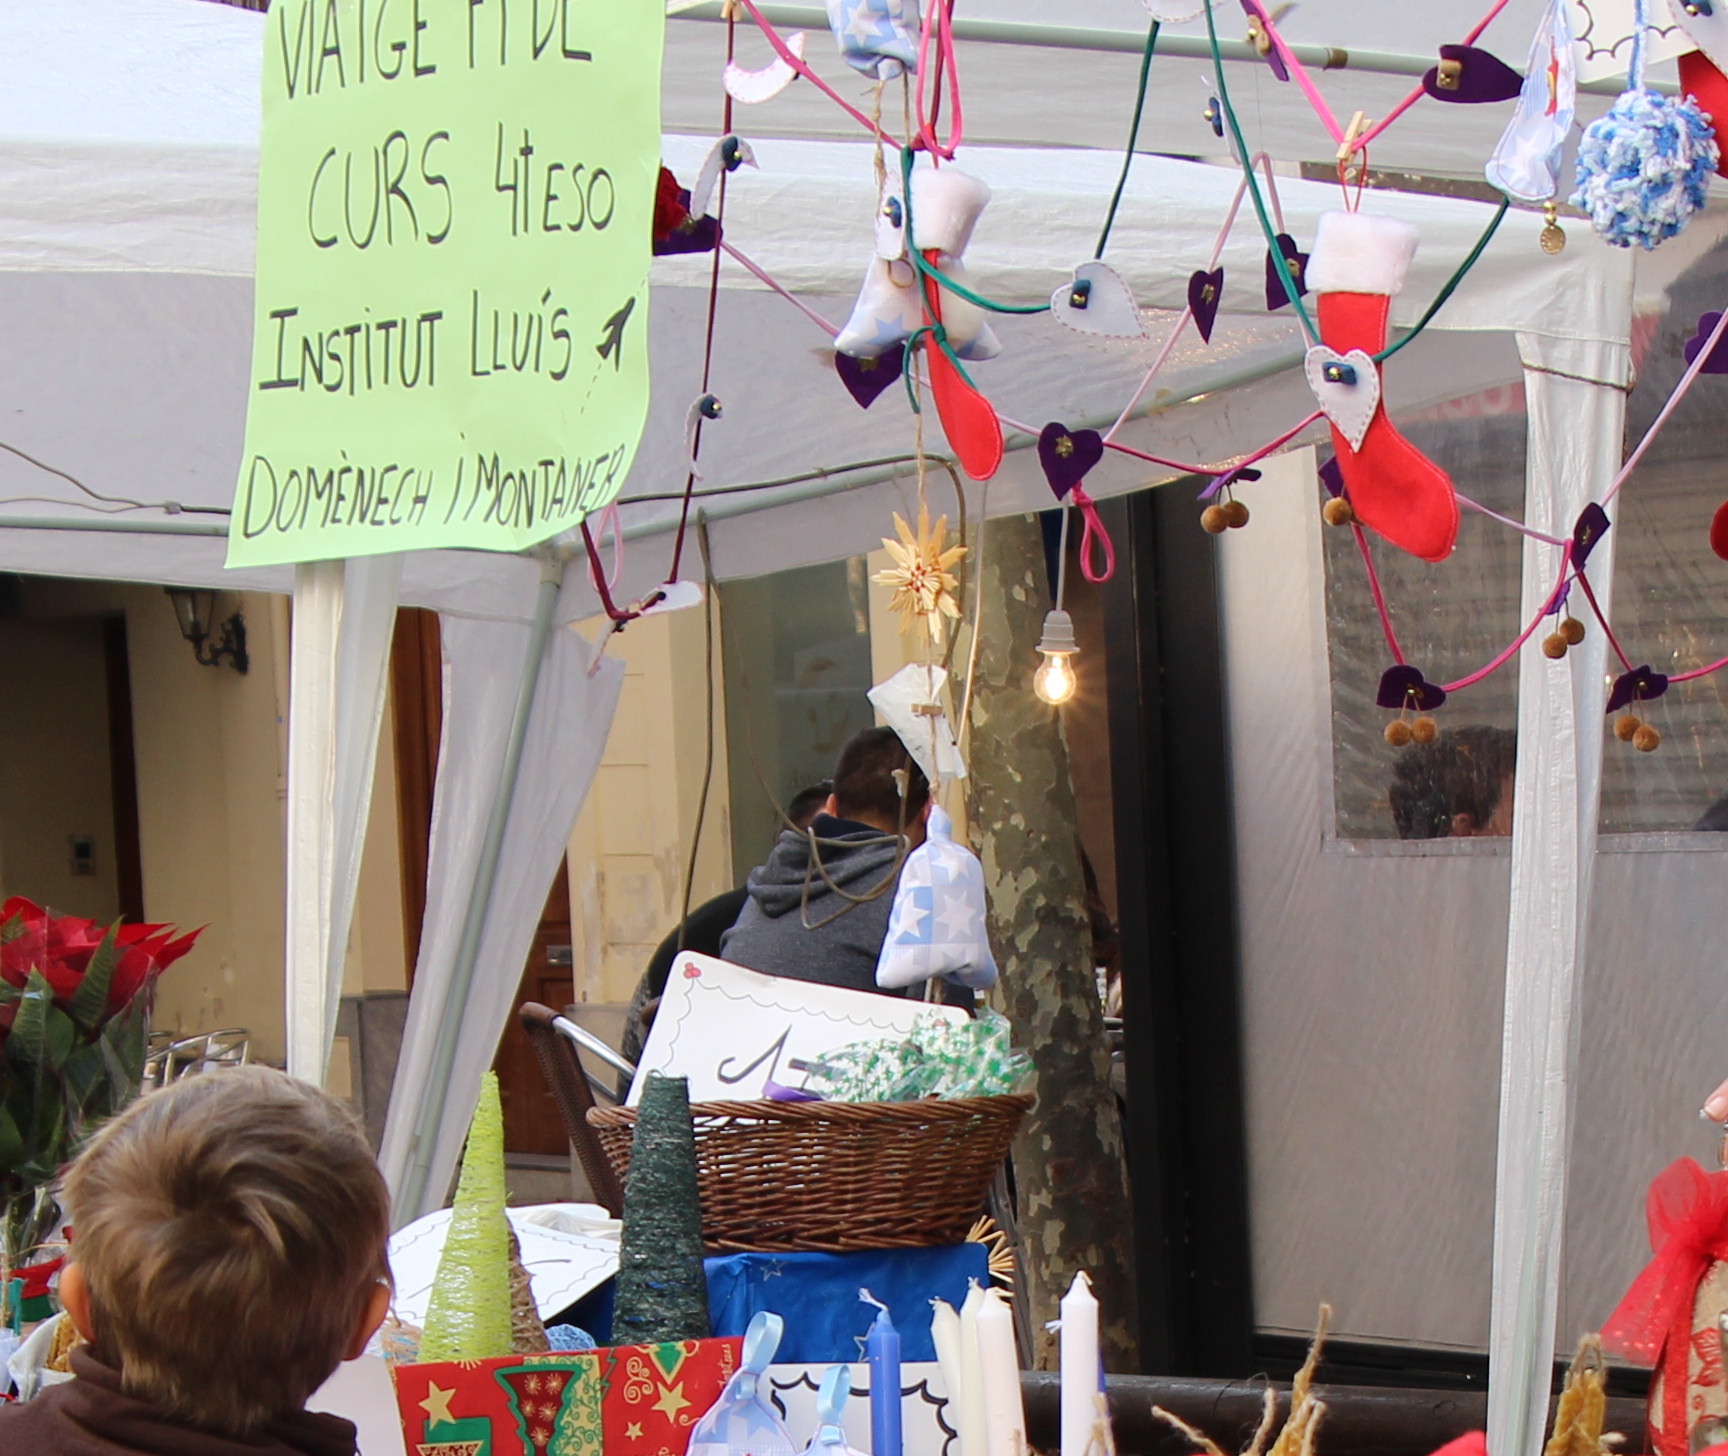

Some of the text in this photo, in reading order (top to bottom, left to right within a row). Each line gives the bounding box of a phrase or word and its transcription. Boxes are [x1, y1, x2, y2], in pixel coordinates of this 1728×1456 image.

[307, 130, 453, 250] CURS
[471, 288, 572, 381] LLUÍS
[242, 449, 434, 539] DOMÈNECH
[462, 442, 626, 530] MONTANER
